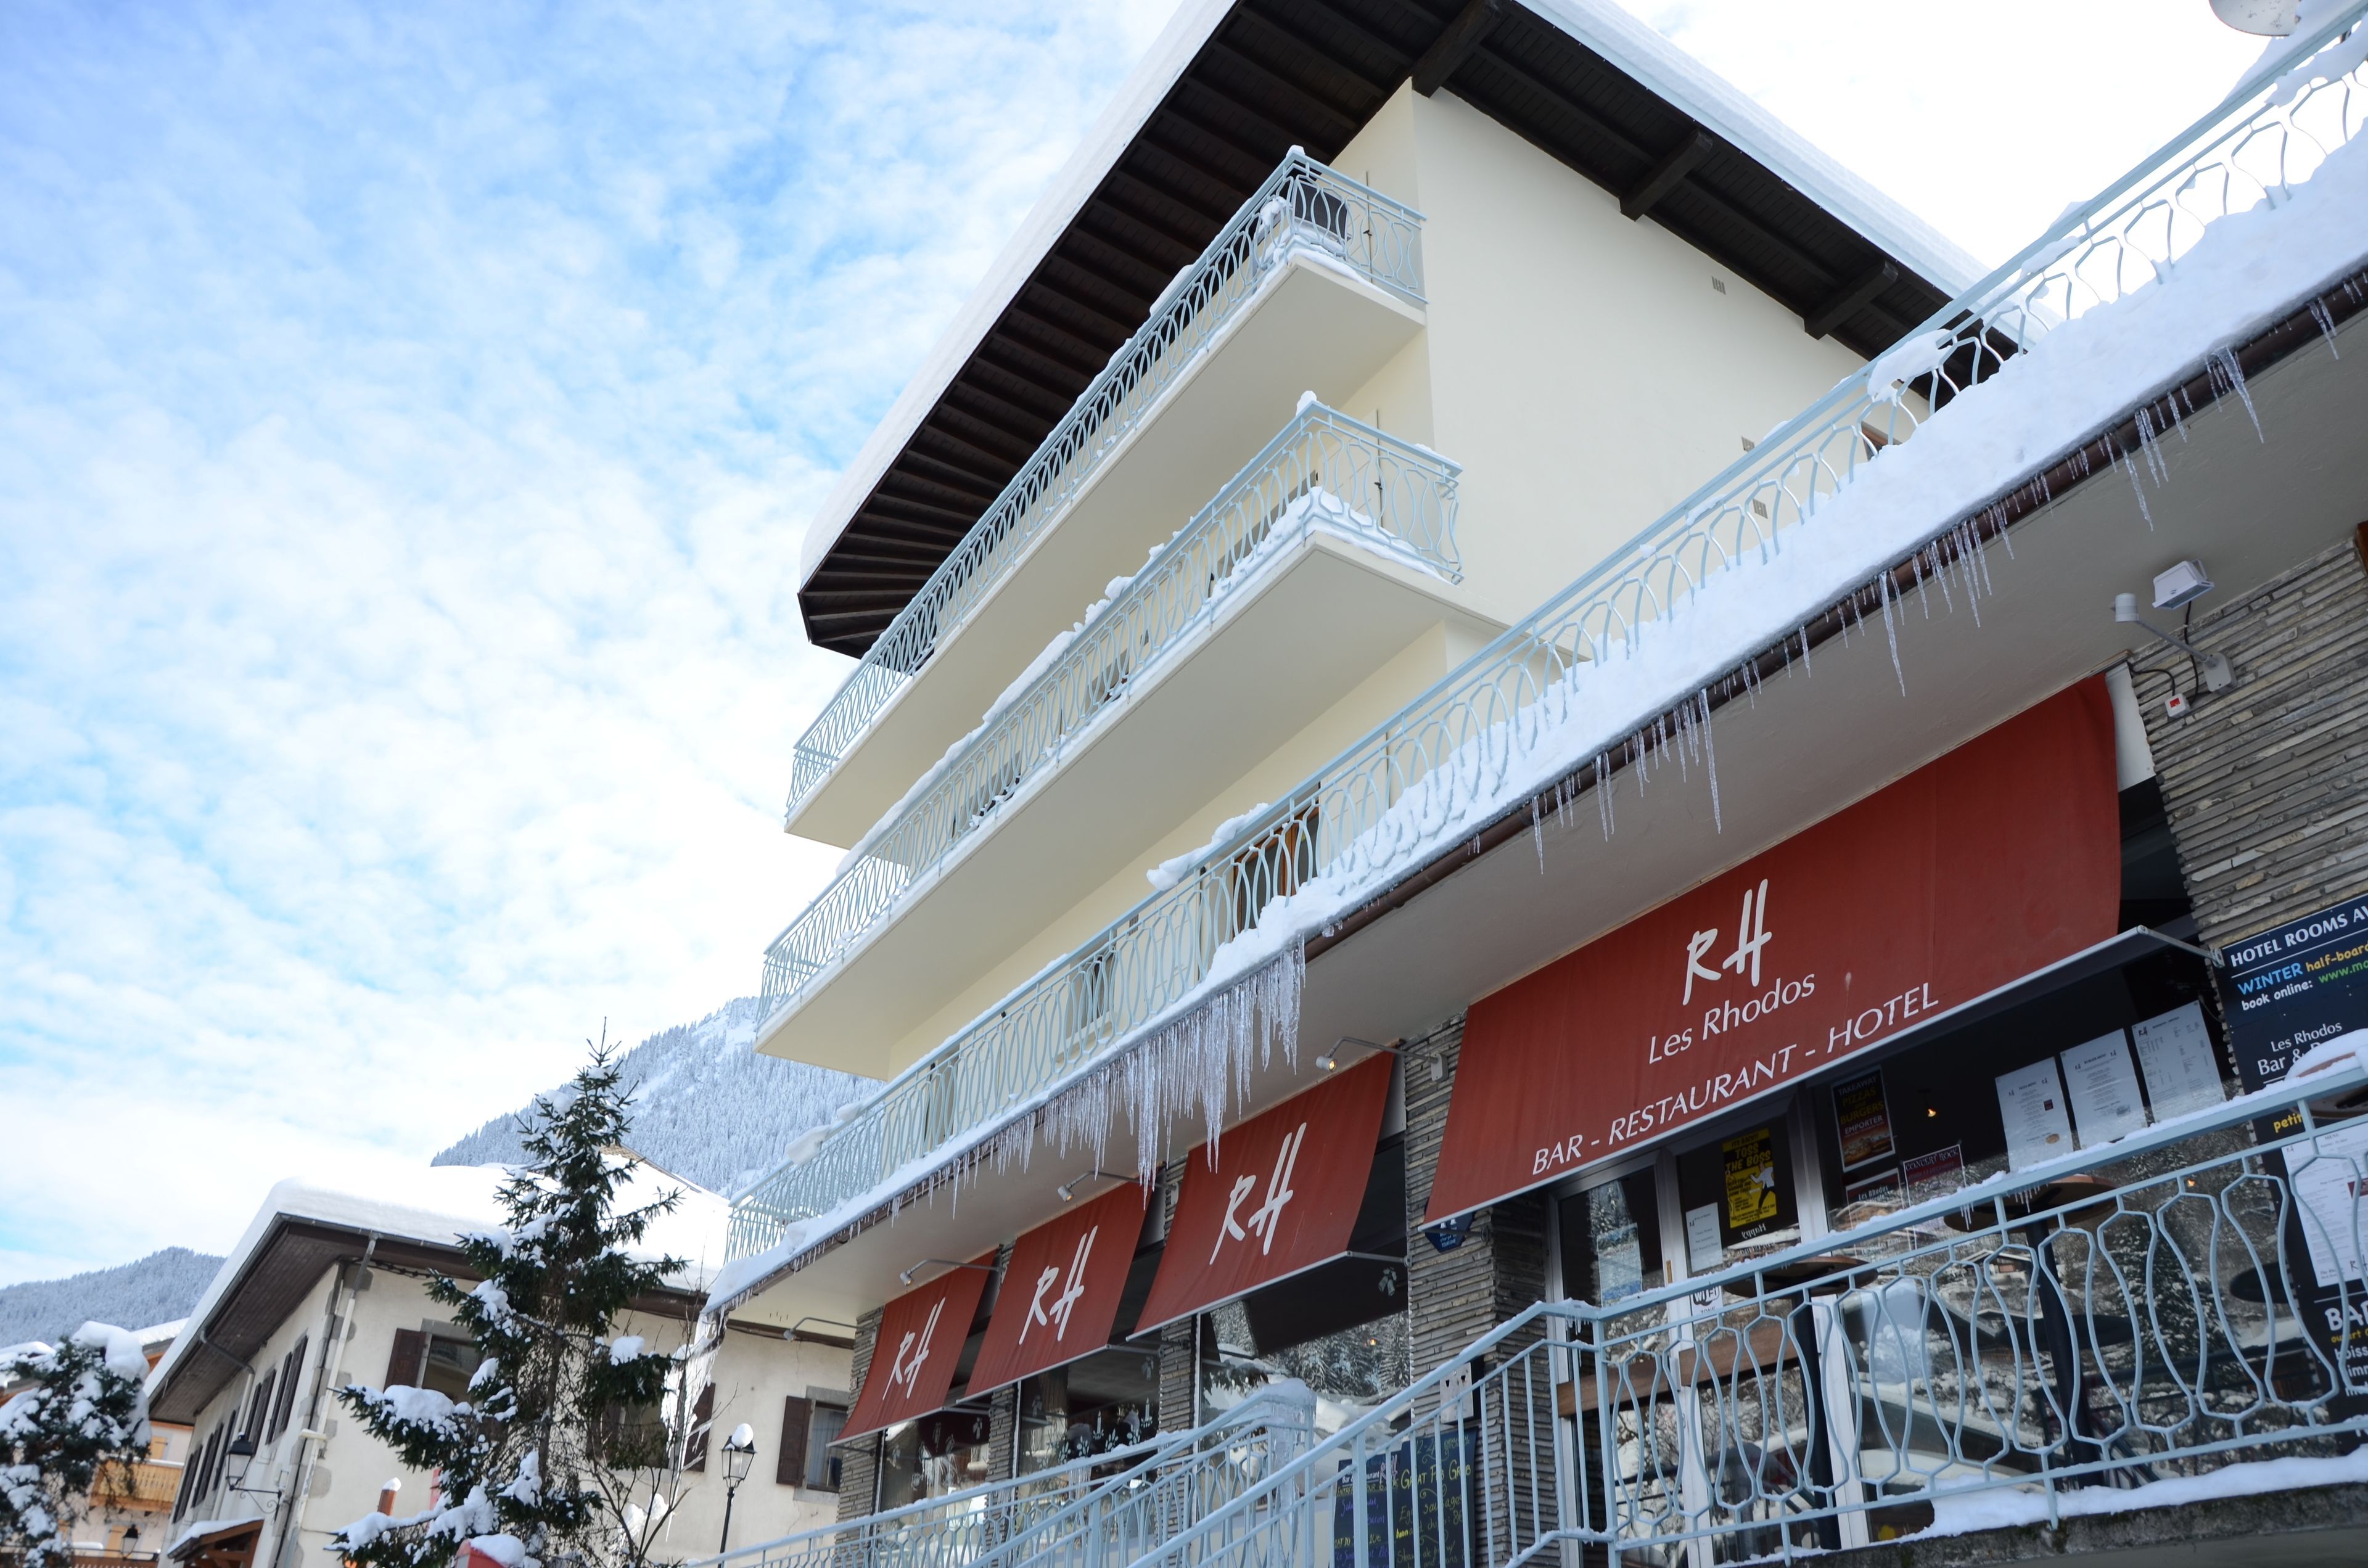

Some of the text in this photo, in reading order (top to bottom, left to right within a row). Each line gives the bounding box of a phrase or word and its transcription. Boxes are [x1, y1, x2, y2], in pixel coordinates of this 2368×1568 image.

[1682, 879, 1772, 1006] RH
[2230, 939, 2282, 967] HOTEL
[2285, 913, 2348, 947] ROOMS
[2238, 963, 2303, 995] WINTER
[2242, 993, 2270, 1011] book
[2274, 980, 2313, 1000] online:
[1648, 974, 1815, 1064] Les Rhodos
[2271, 1022, 2343, 1053] Les Rhodos
[1532, 1135, 1583, 1175] BAR
[1609, 1044, 1797, 1145] RESTAURANT
[1827, 982, 1939, 1053] HOTEL
[2257, 1056, 2285, 1075] Bar
[1839, 1075, 1877, 1096] TAKEAWAY
[1842, 1086, 1876, 1107] PIZZAS
[1840, 1101, 1885, 1124] BURGERS
[1845, 1115, 1883, 1135] EMPORTER
[1725, 1149, 1771, 1173] THE BOSS
[1735, 1143, 1759, 1159] TOSS
[1906, 1147, 1957, 1171] CONCERT ROCK
[1209, 1122, 1307, 1265] RH
[1858, 1193, 1867, 1201] Les
[1868, 1185, 1888, 1197] Rhodos
[1019, 1225, 1098, 1345] RH
[882, 1297, 946, 1400] RH
[1449, 1459, 1471, 1480] GRB
